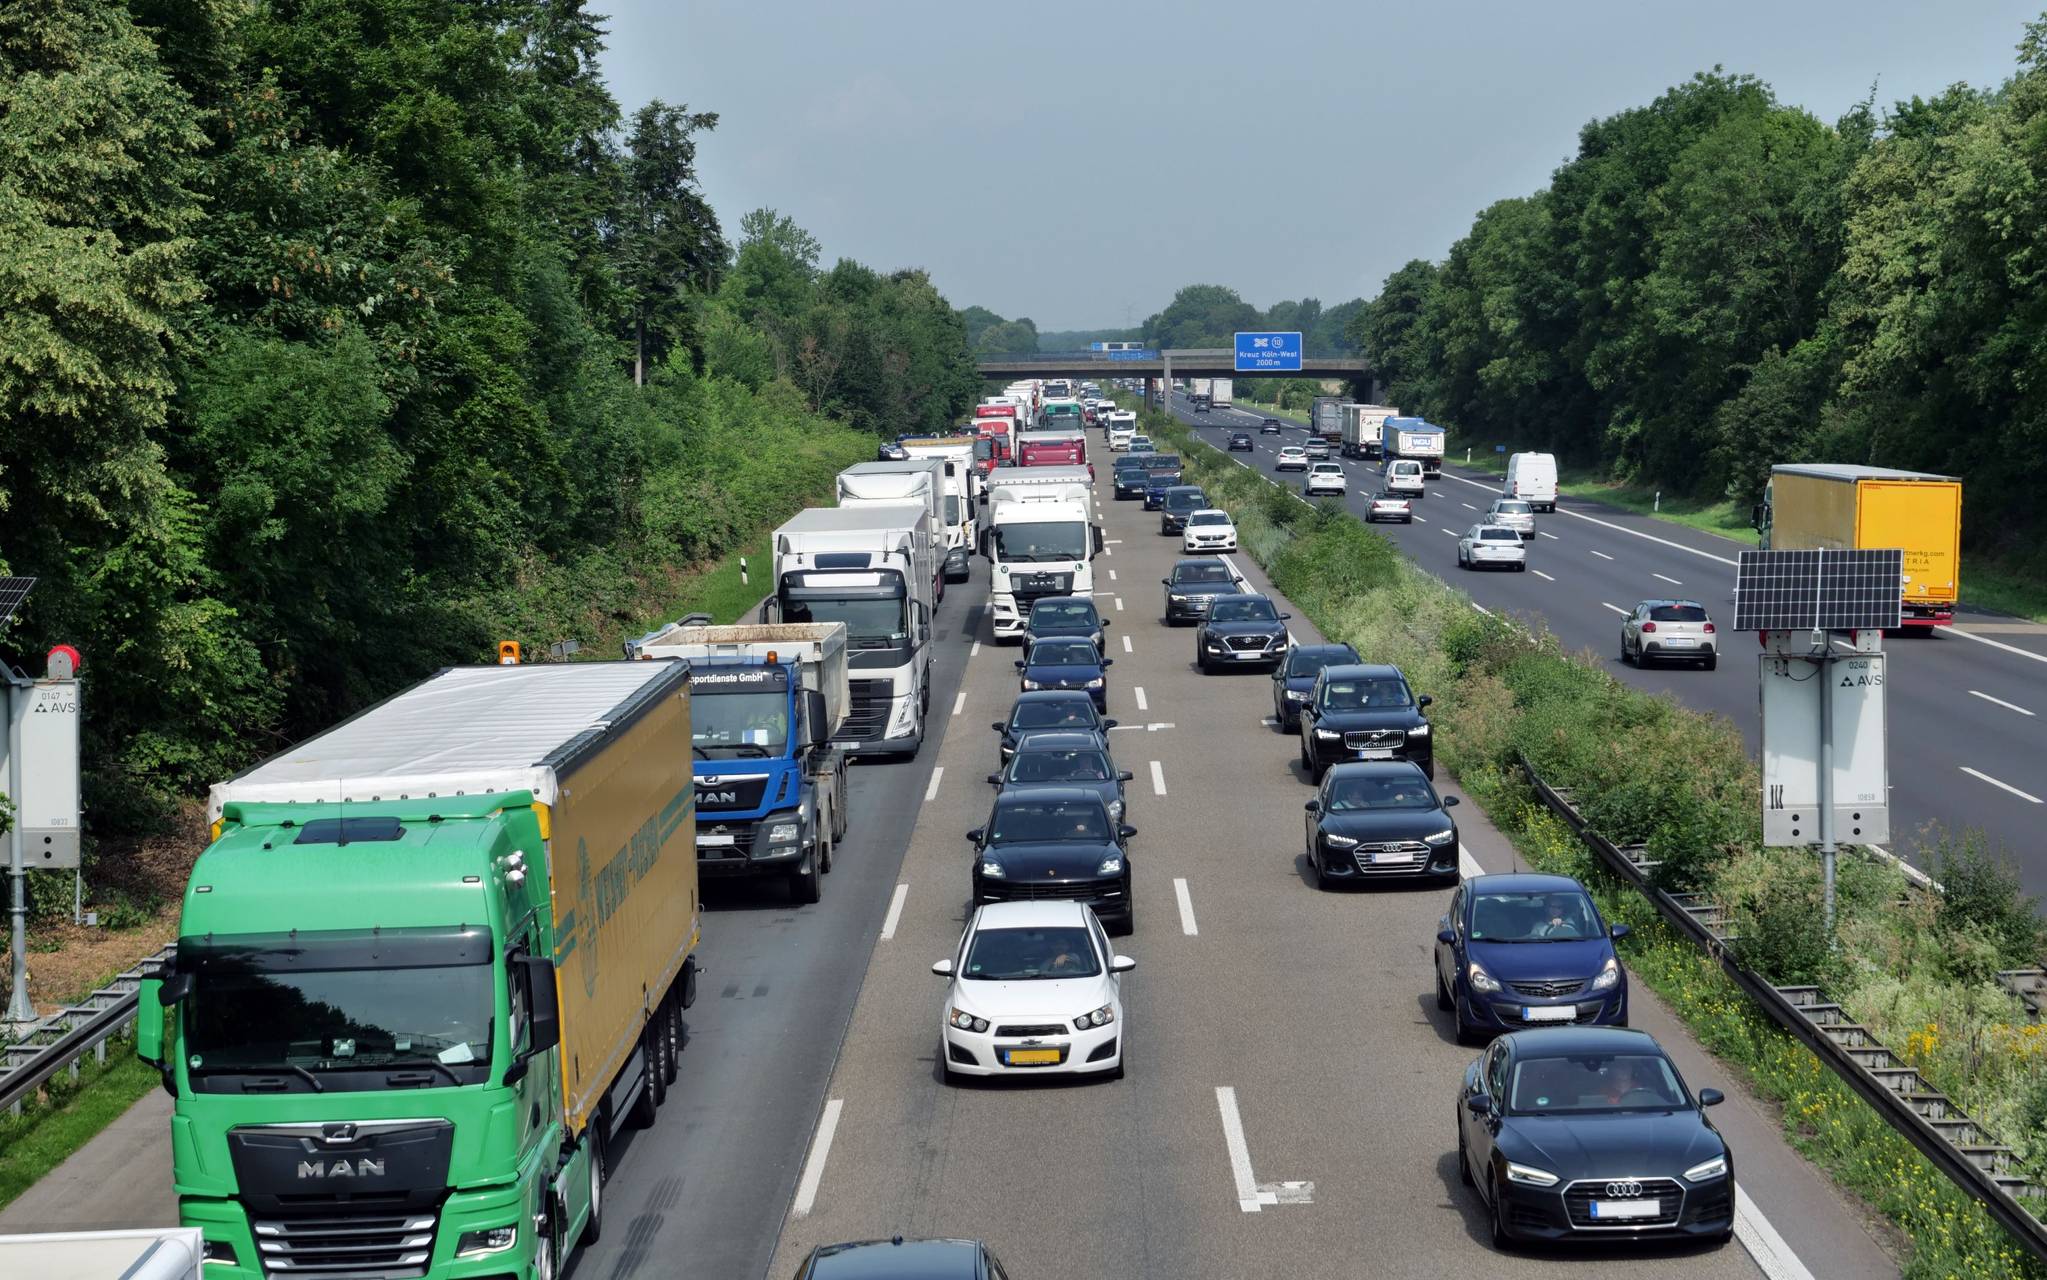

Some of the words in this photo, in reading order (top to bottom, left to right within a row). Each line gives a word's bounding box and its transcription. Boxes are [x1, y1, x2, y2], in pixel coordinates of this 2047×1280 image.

[1848, 661, 1868, 669] 0240
[689, 674, 737, 685] sportdienste
[739, 672, 763, 682] GmbH
[1857, 675, 1882, 686] AVS
[41, 692, 60, 700] 0147
[51, 703, 76, 713] AVS
[298, 1159, 384, 1178] MAN
